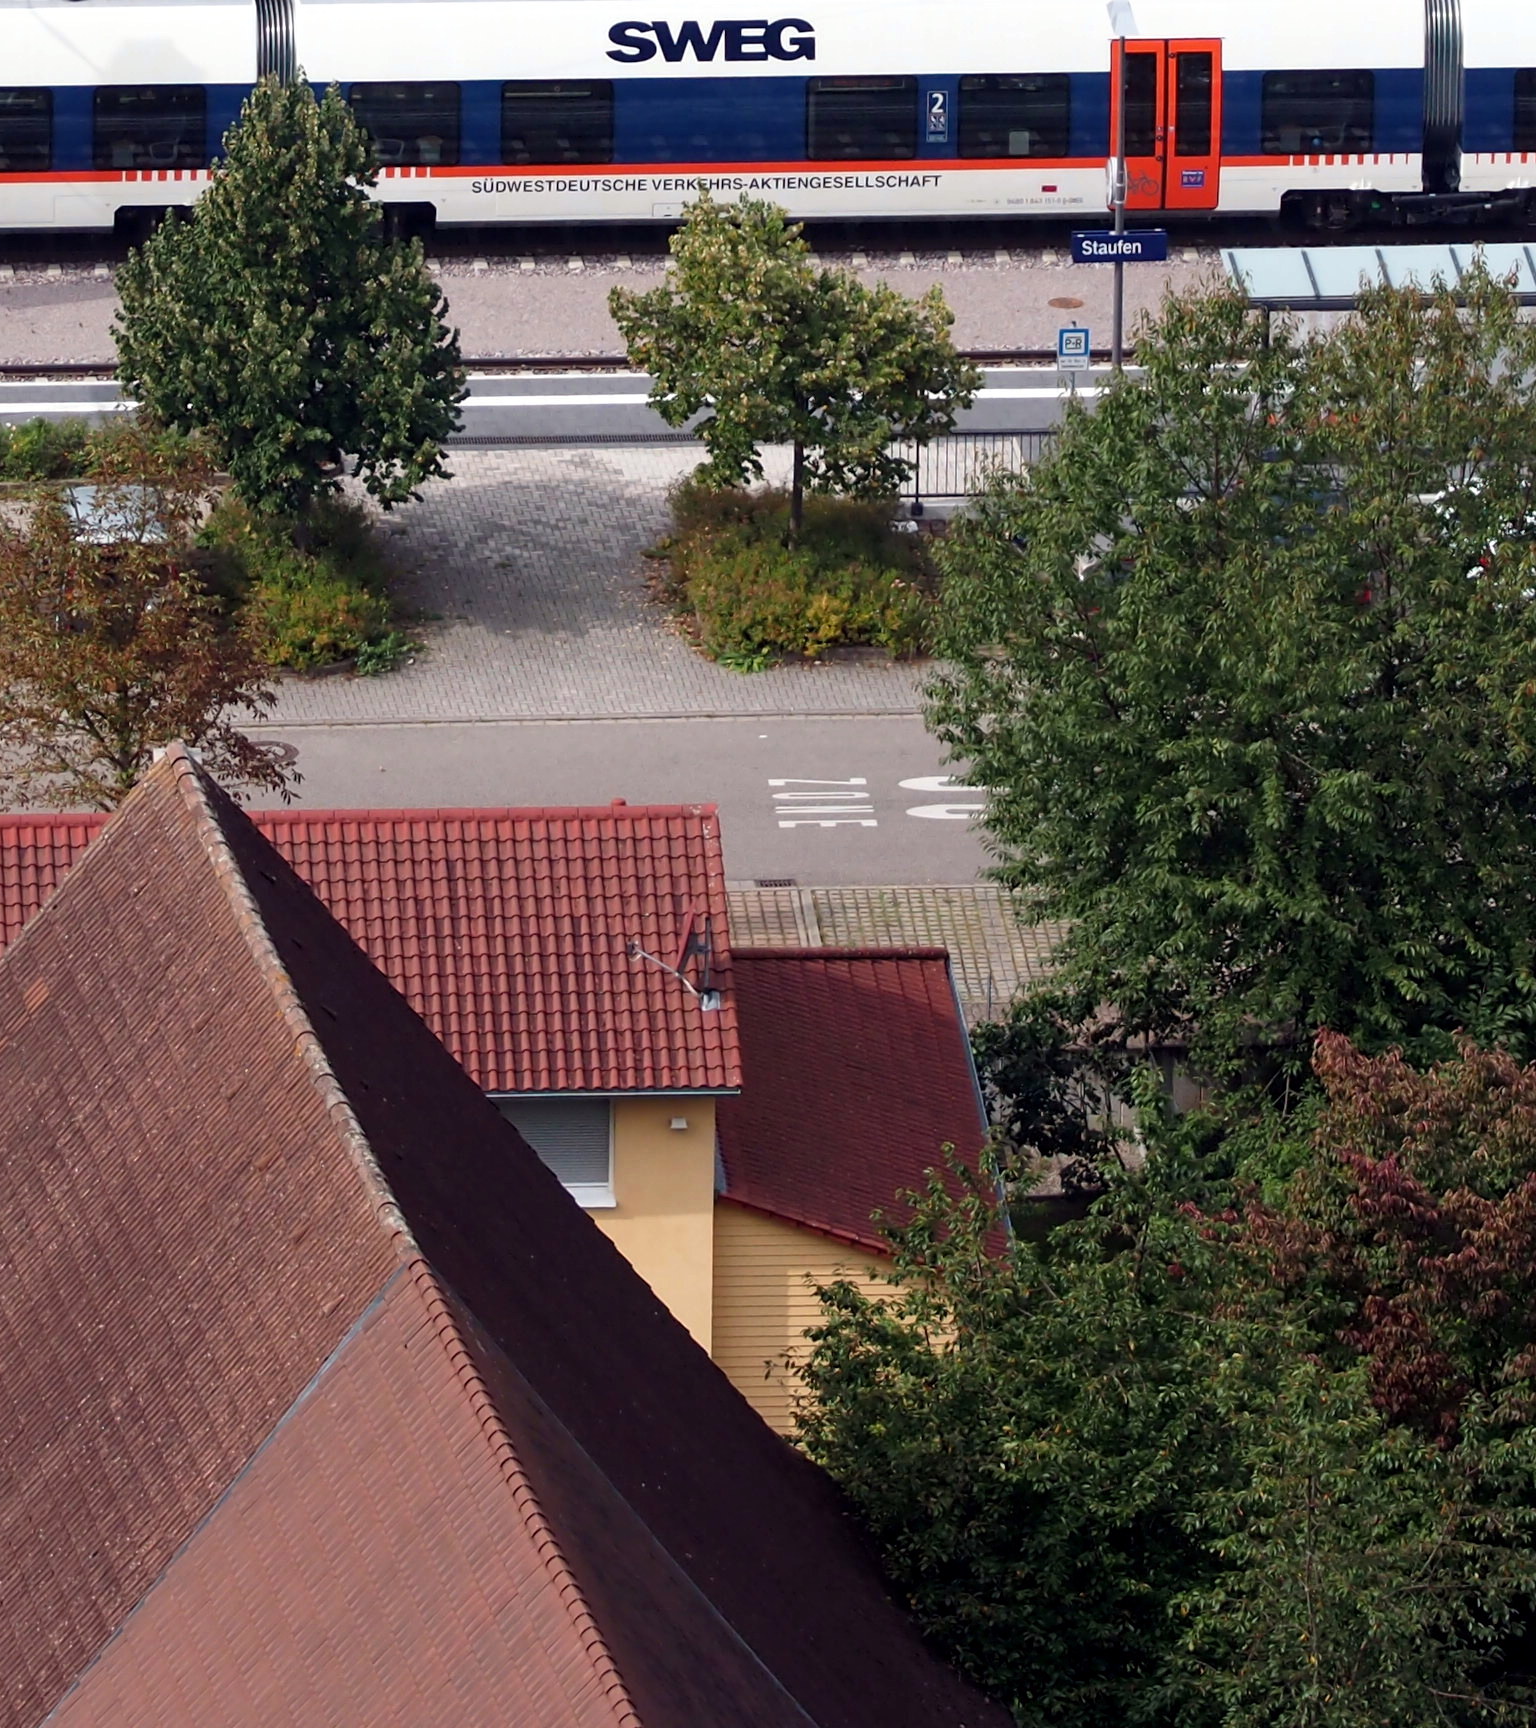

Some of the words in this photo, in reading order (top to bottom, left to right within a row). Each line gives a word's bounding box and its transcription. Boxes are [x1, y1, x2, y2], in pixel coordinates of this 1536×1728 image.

[605, 18, 816, 63] SWEG
[931, 93, 944, 113] 2
[472, 178, 647, 193] SÜDWESTDEUTSCHE
[1082, 239, 1142, 255] Staufen
